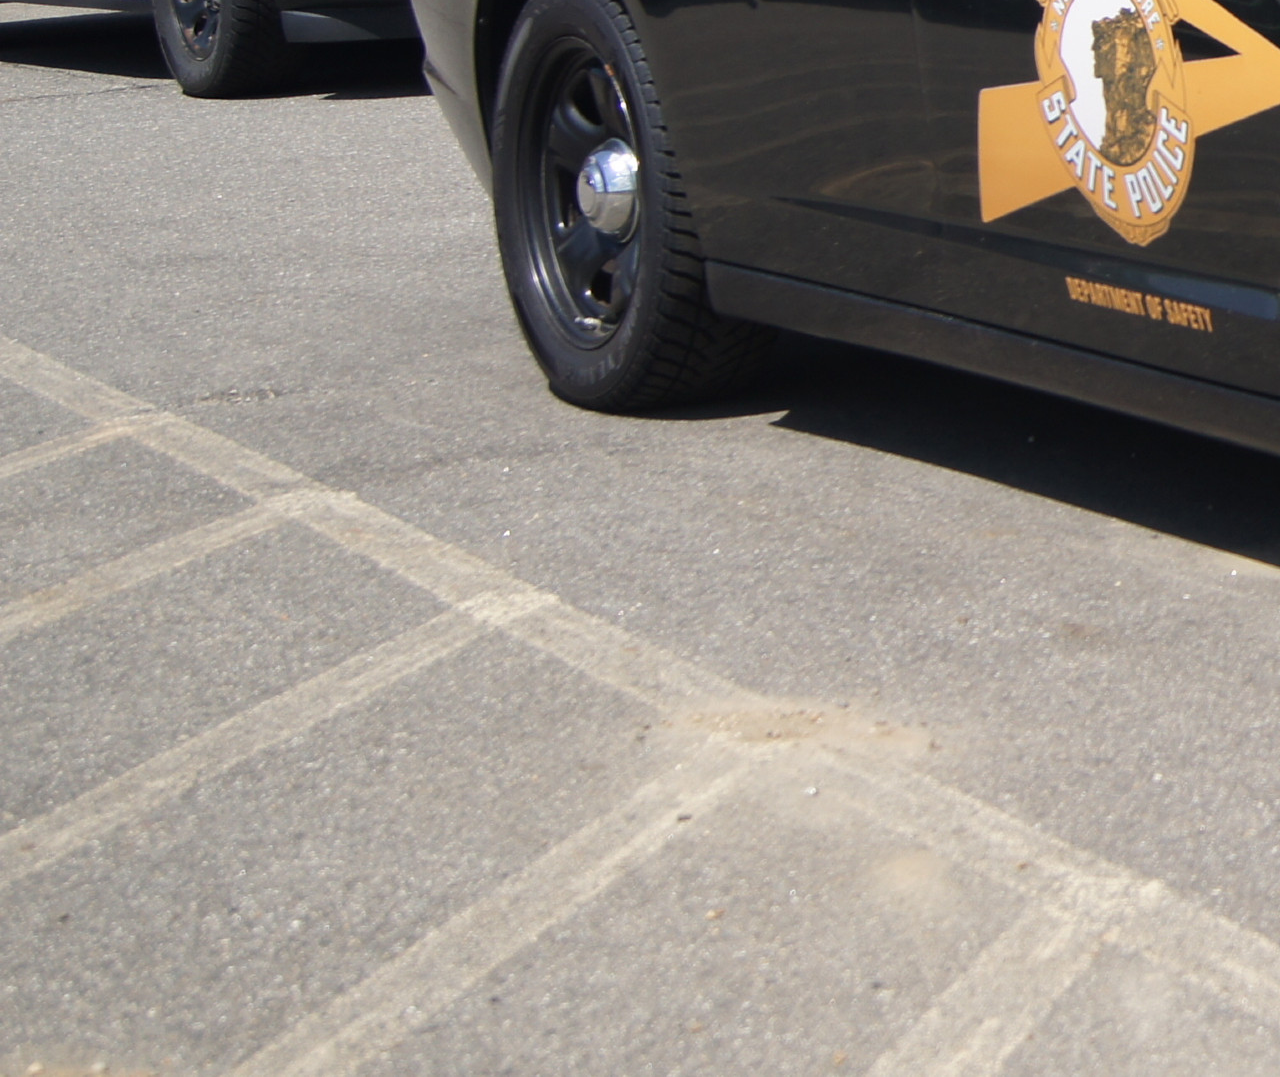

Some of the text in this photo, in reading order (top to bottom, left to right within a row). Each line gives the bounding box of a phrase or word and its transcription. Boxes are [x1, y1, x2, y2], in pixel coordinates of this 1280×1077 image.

[1042, 90, 1189, 219] STATE POLICE
[1065, 276, 1214, 333] DEPARTMENT OF SAFETY
